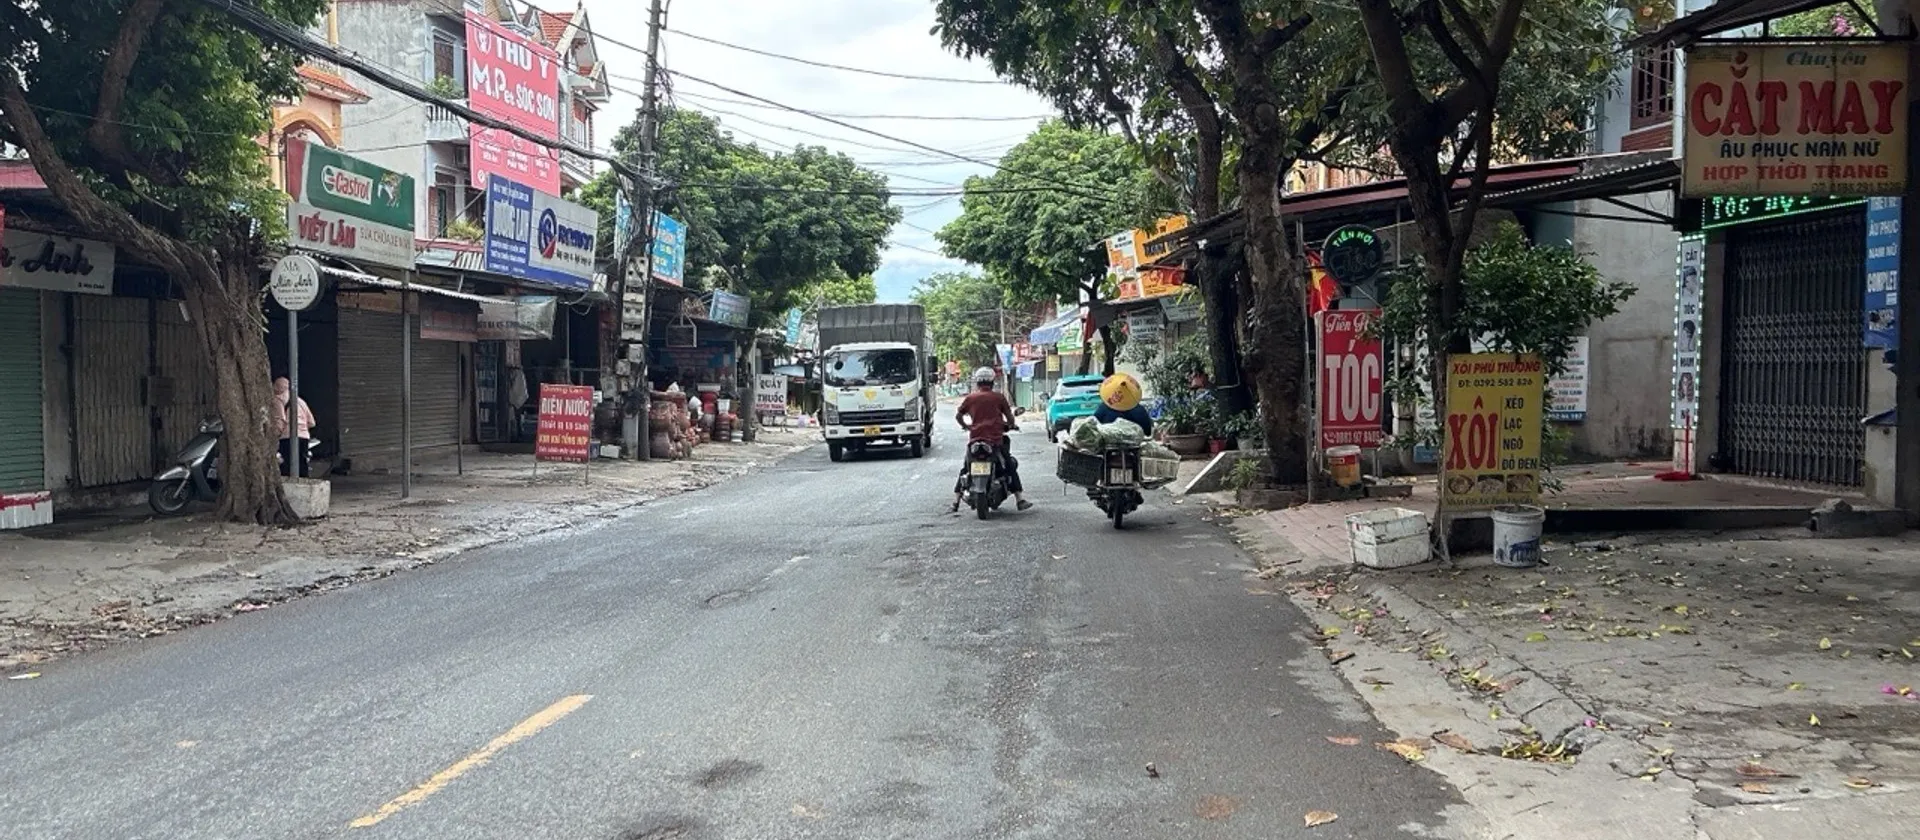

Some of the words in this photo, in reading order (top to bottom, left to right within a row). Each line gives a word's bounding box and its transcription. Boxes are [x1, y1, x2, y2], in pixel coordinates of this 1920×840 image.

[495, 36, 533, 72] THÚ
[538, 54, 550, 79] Y
[516, 81, 535, 114] SÓC
[1691, 51, 1788, 137] CẮT
[1797, 80, 1904, 135] MAY
[1720, 139, 1745, 158] ÂU
[1752, 142, 1799, 162] PHỤC
[1805, 141, 1846, 157] NAM
[1854, 138, 1881, 157] NỮ
[335, 171, 370, 201] Castrol
[1703, 165, 1748, 184] HỢP
[1756, 162, 1807, 181] THỜI
[1816, 164, 1889, 179] TRANG
[21, 239, 94, 275] Anh
[1453, 361, 1472, 375] XÔI
[1680, 357, 1694, 367] NAM
[1325, 339, 1380, 422] TÓC
[541, 395, 564, 418] ĐIỆN
[565, 396, 590, 417] NƯỚC
[1446, 395, 1498, 470] XÔI
[1504, 418, 1523, 433] LẠC
[1518, 458, 1538, 470] ĐEN
